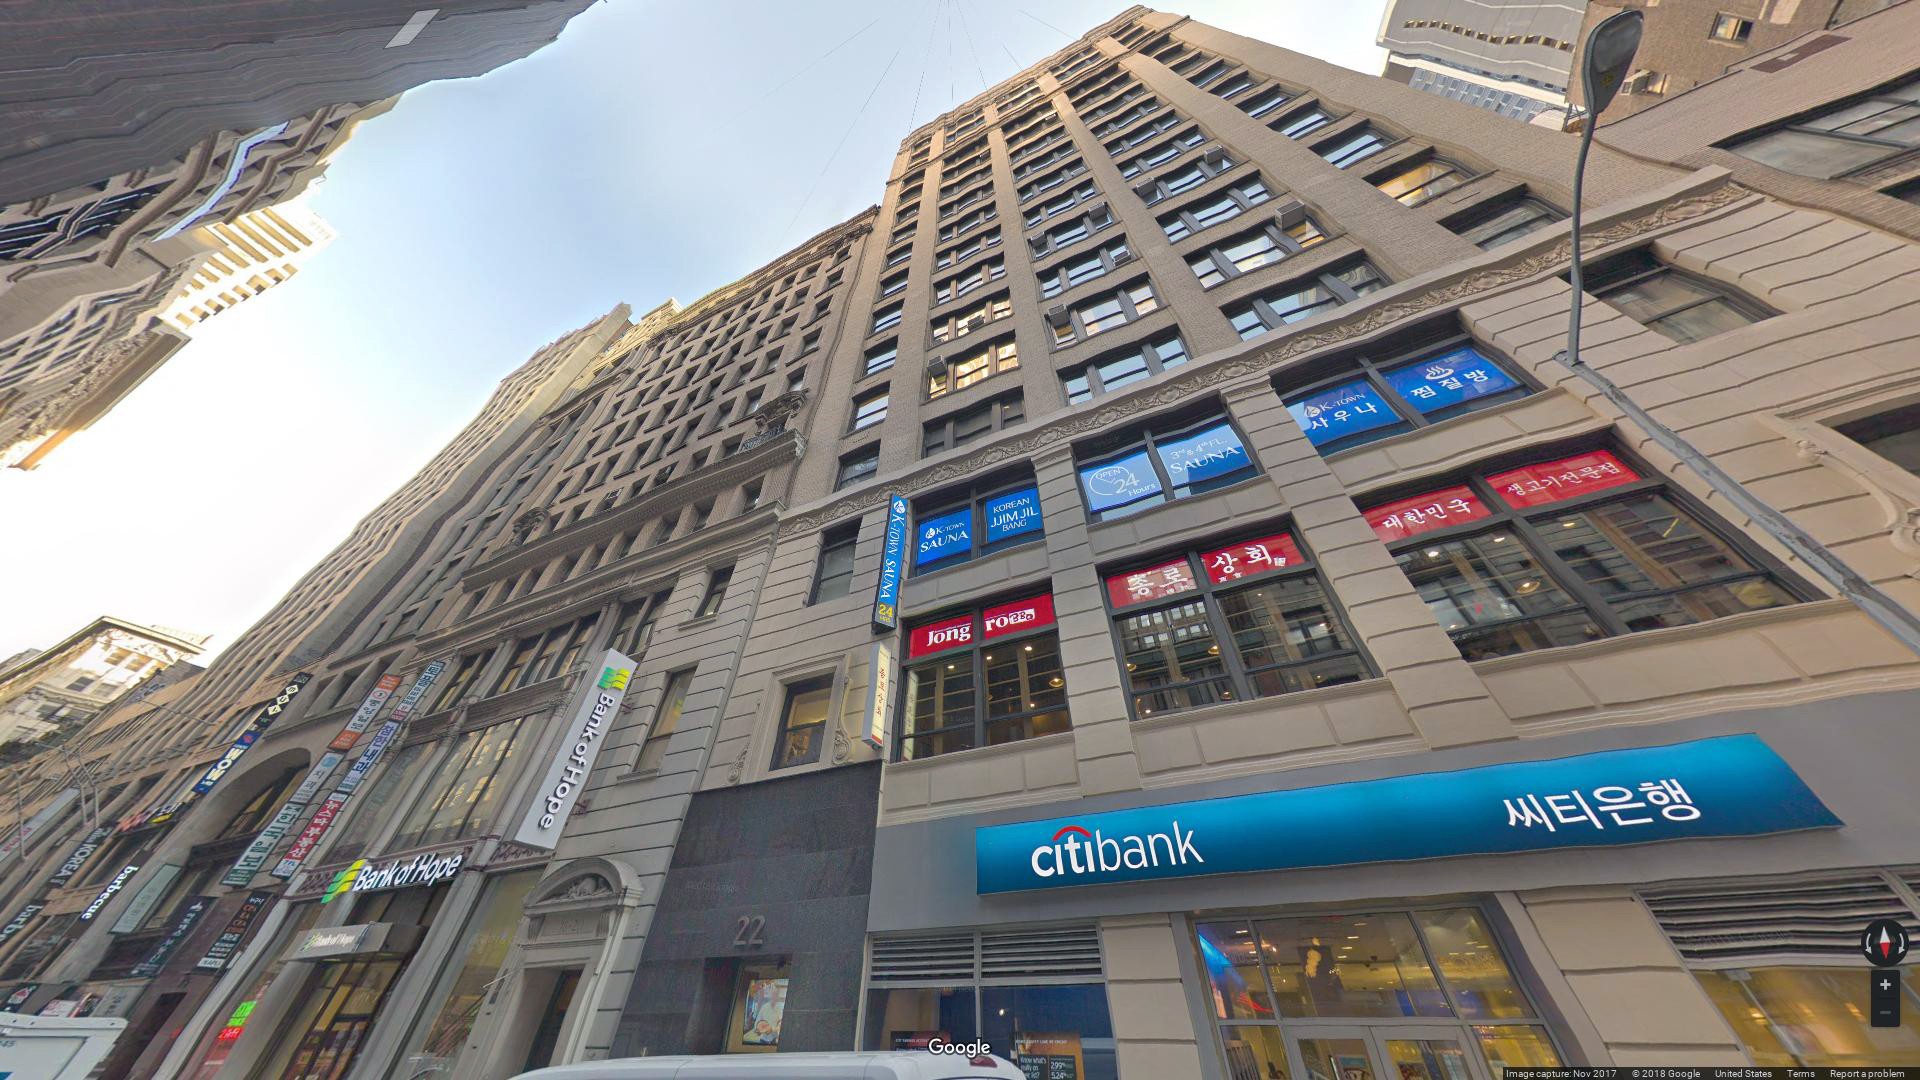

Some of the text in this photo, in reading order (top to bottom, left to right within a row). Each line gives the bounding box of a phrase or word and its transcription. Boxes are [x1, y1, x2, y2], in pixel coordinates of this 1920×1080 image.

[1409, 368, 1489, 400] 찜질방
[1310, 401, 1378, 431] 사우나
[1320, 392, 1366, 411] K-TOWN
[1094, 468, 1122, 480] OPEN
[1170, 446, 1241, 474] SAUNA
[1113, 473, 1140, 493] 24
[1127, 483, 1156, 497] Hours
[1506, 461, 1621, 497] 생고기전문점
[993, 497, 1030, 514] KOREAN
[1381, 497, 1472, 532] 대한민국
[920, 530, 969, 553] SAUNA
[935, 522, 965, 536] K-TOWN
[1002, 519, 1027, 532] BANG
[880, 514, 905, 599] K-TOWN SAUNA
[1127, 567, 1188, 596] 종로
[1210, 544, 1273, 574] 상회
[878, 604, 893, 618] 24
[926, 610, 1034, 647] Jong ro BBQ
[538, 692, 615, 831] Bank of Hope
[1502, 778, 1701, 833] 씨티은행
[55, 843, 98, 878] KOREA
[1031, 820, 1204, 877] citibank
[352, 852, 463, 892] Bank of Hope
[81, 865, 140, 920] barbecue
[733, 914, 766, 946] 22
